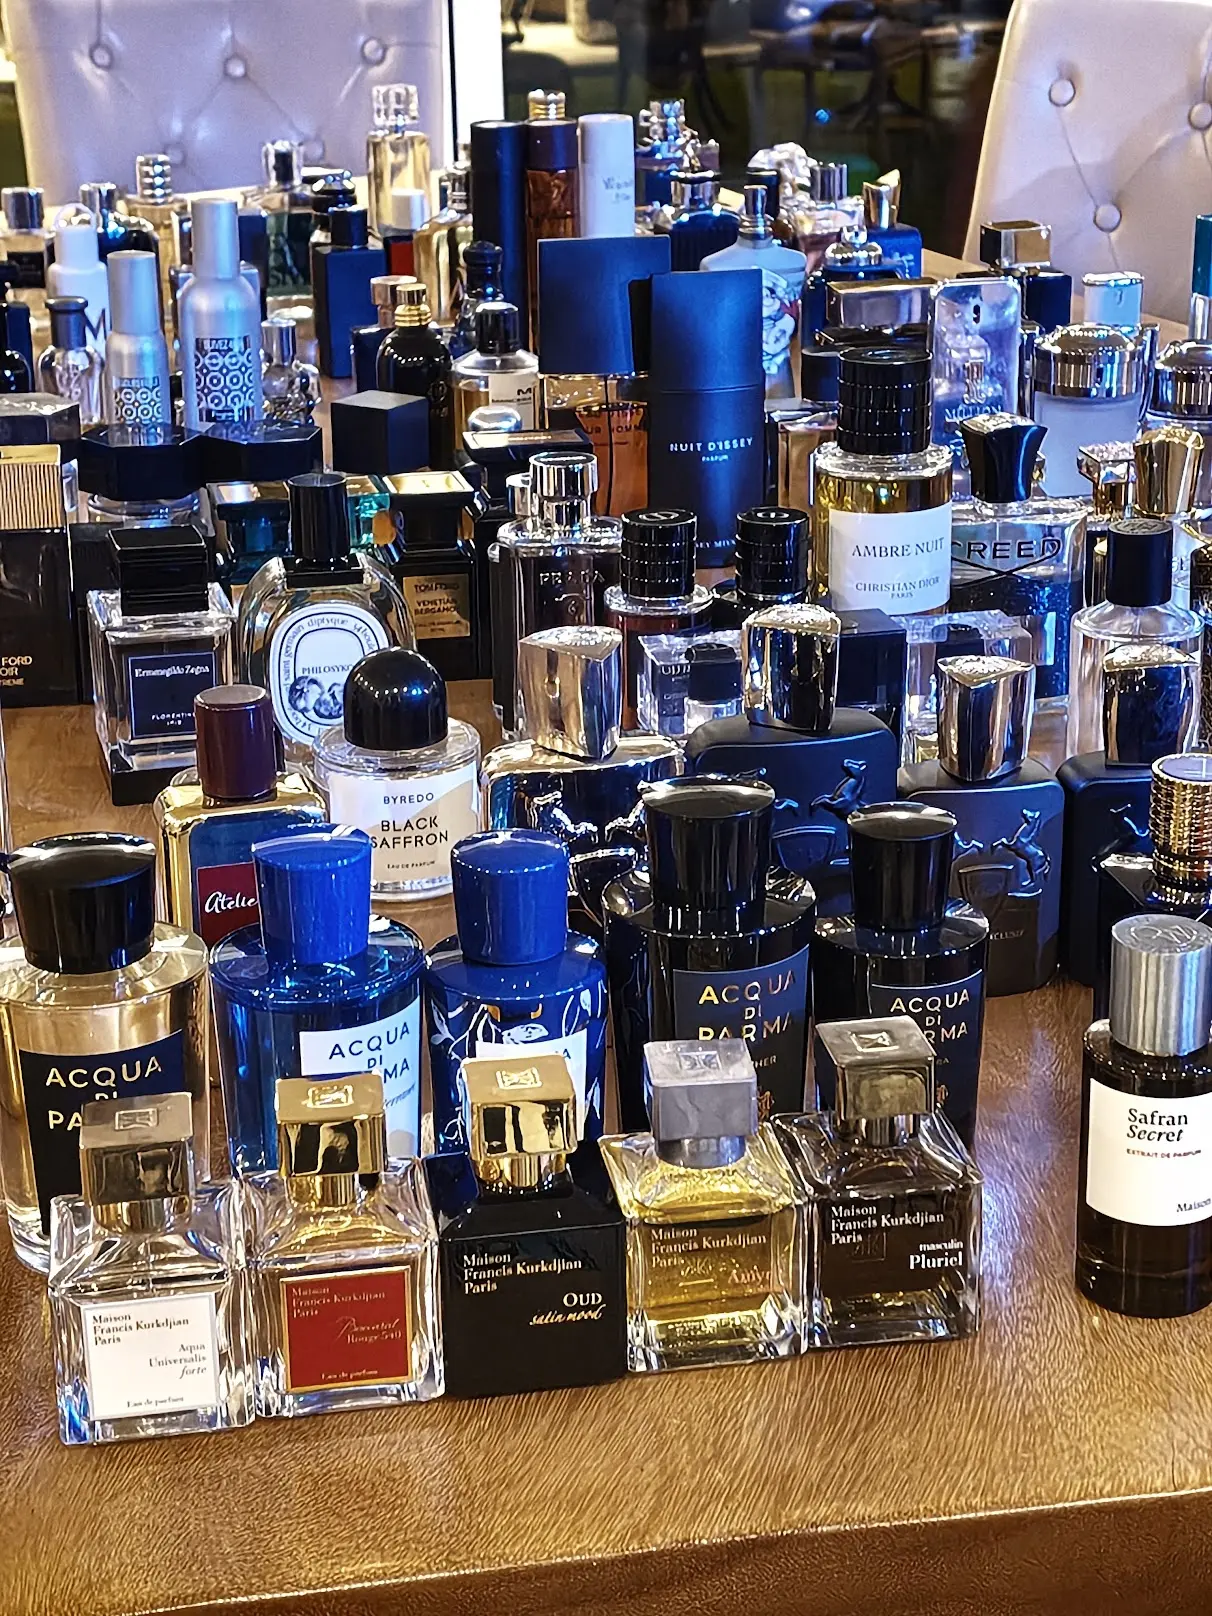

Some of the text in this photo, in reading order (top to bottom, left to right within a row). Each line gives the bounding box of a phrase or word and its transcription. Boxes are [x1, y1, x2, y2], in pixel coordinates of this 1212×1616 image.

[669, 443, 702, 452] NUIT
[852, 537, 944, 558] AMBRE NUIT
[855, 576, 940, 592] CHRISTIAN DIOR
[2, 655, 33, 666] FORD
[0, 667, 18, 677] OIR
[383, 792, 434, 805] BYREDO
[381, 815, 439, 832] BLACK
[370, 830, 448, 849] SAFFRON
[204, 891, 259, 914] Atelie
[698, 969, 796, 1005] ACQUA
[889, 988, 970, 1013] ACQUA
[744, 1004, 762, 1020] DI
[925, 1015, 942, 1027] DI
[924, 1021, 968, 1044] RMA
[329, 1021, 410, 1060] ACQUA
[367, 1054, 383, 1069] DI
[45, 1055, 162, 1088] ACQUA
[1127, 1107, 1188, 1126] Safran
[1126, 1124, 1184, 1142] Secret
[1126, 1148, 1158, 1158] EXTRAIT
[831, 1204, 877, 1217] Maison
[831, 1211, 944, 1231] Francis Kurkdjian
[651, 1228, 698, 1241] Maison
[831, 1231, 863, 1245] Paris
[651, 1233, 767, 1255] Francis Kurkdjian
[463, 1253, 511, 1268] Maison
[909, 1251, 963, 1270] Pluriel
[464, 1258, 582, 1281] Francis Kurkdjian
[292, 1287, 330, 1297] Maison
[464, 1280, 498, 1295] Paris
[293, 1292, 386, 1308] Francis Kurkdjian
[562, 1292, 603, 1307] OUD
[92, 1313, 131, 1325] Maison
[294, 1308, 319, 1318] Paris
[529, 1303, 607, 1326] satin mood
[93, 1317, 190, 1335] Francis Kurkdjian
[94, 1335, 121, 1346] Paris
[178, 1343, 206, 1355] Aqua
[149, 1353, 206, 1368] Universalis
[179, 1365, 207, 1380] forte
[126, 1400, 142, 1408] Eau
